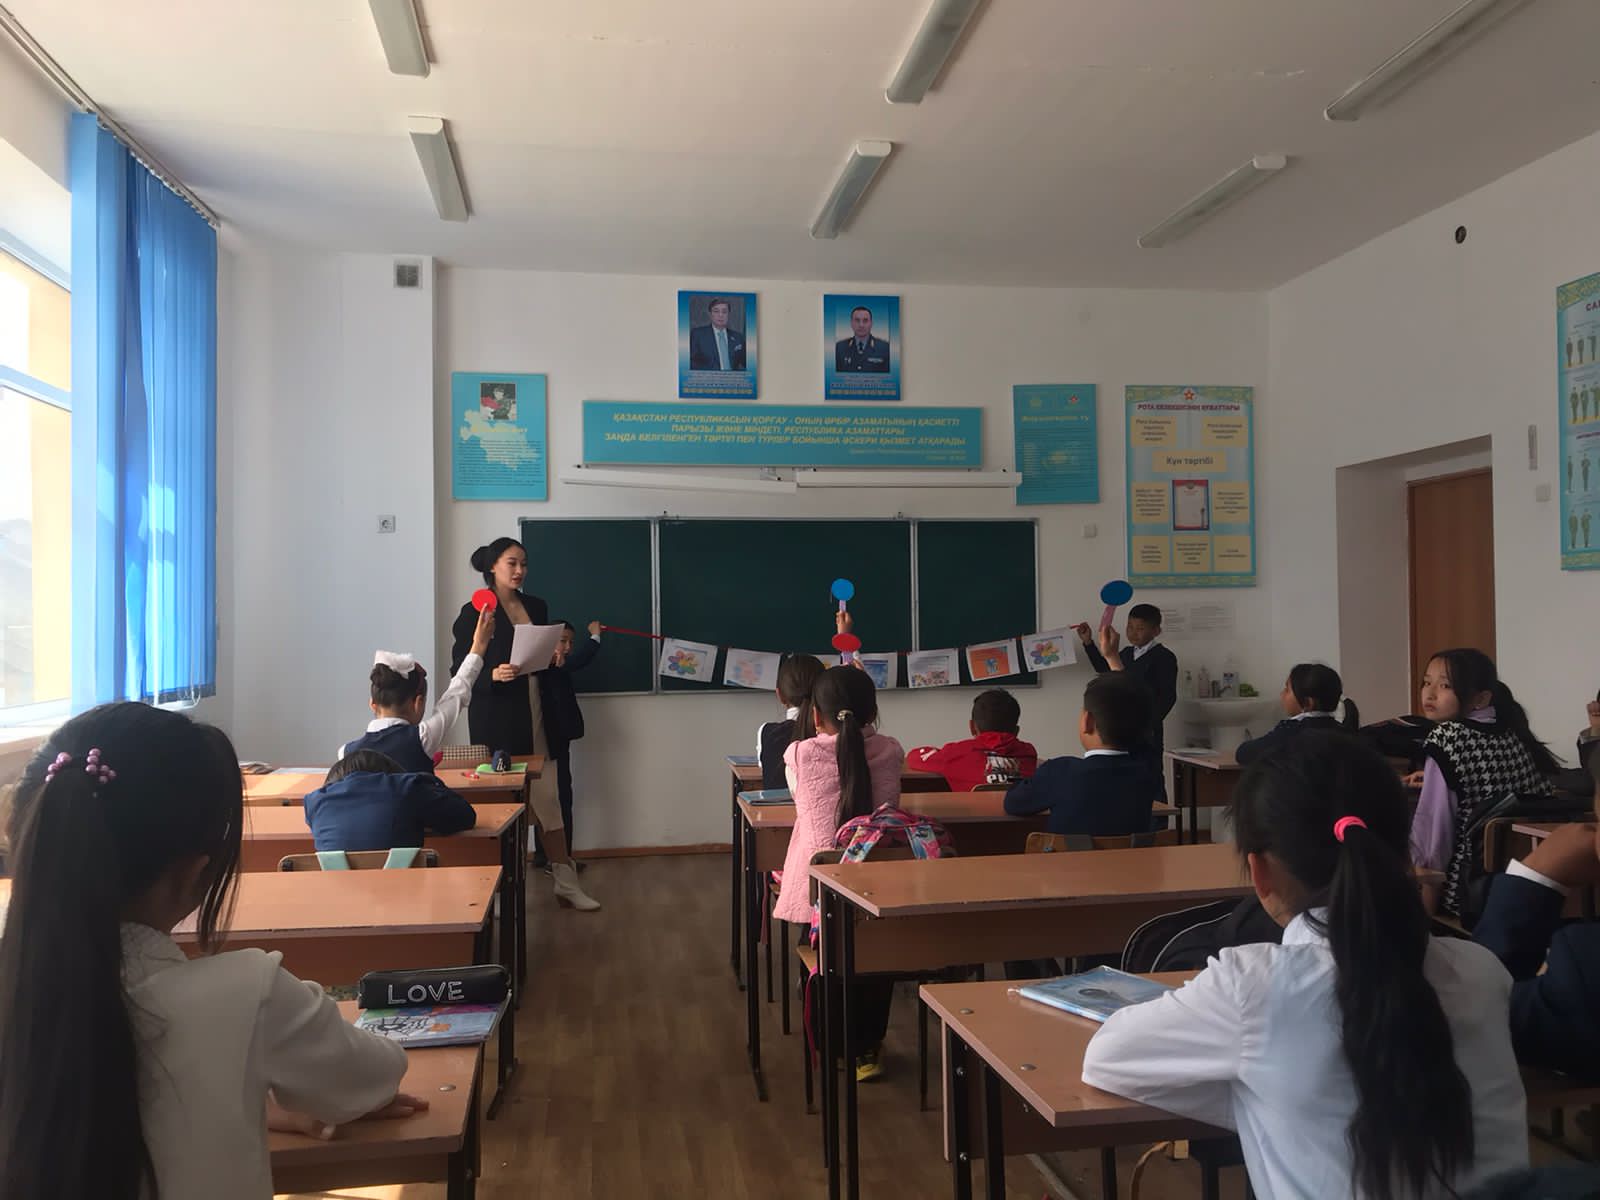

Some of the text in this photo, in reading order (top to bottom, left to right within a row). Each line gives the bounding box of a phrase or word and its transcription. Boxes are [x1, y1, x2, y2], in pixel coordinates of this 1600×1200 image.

[613, 412, 666, 424] ҚАЗАҚСТАН
[669, 414, 751, 424] РЕСПУБЛИКАСЫН
[605, 432, 636, 443] ЗАҢДА
[388, 981, 465, 1005] LOVE
